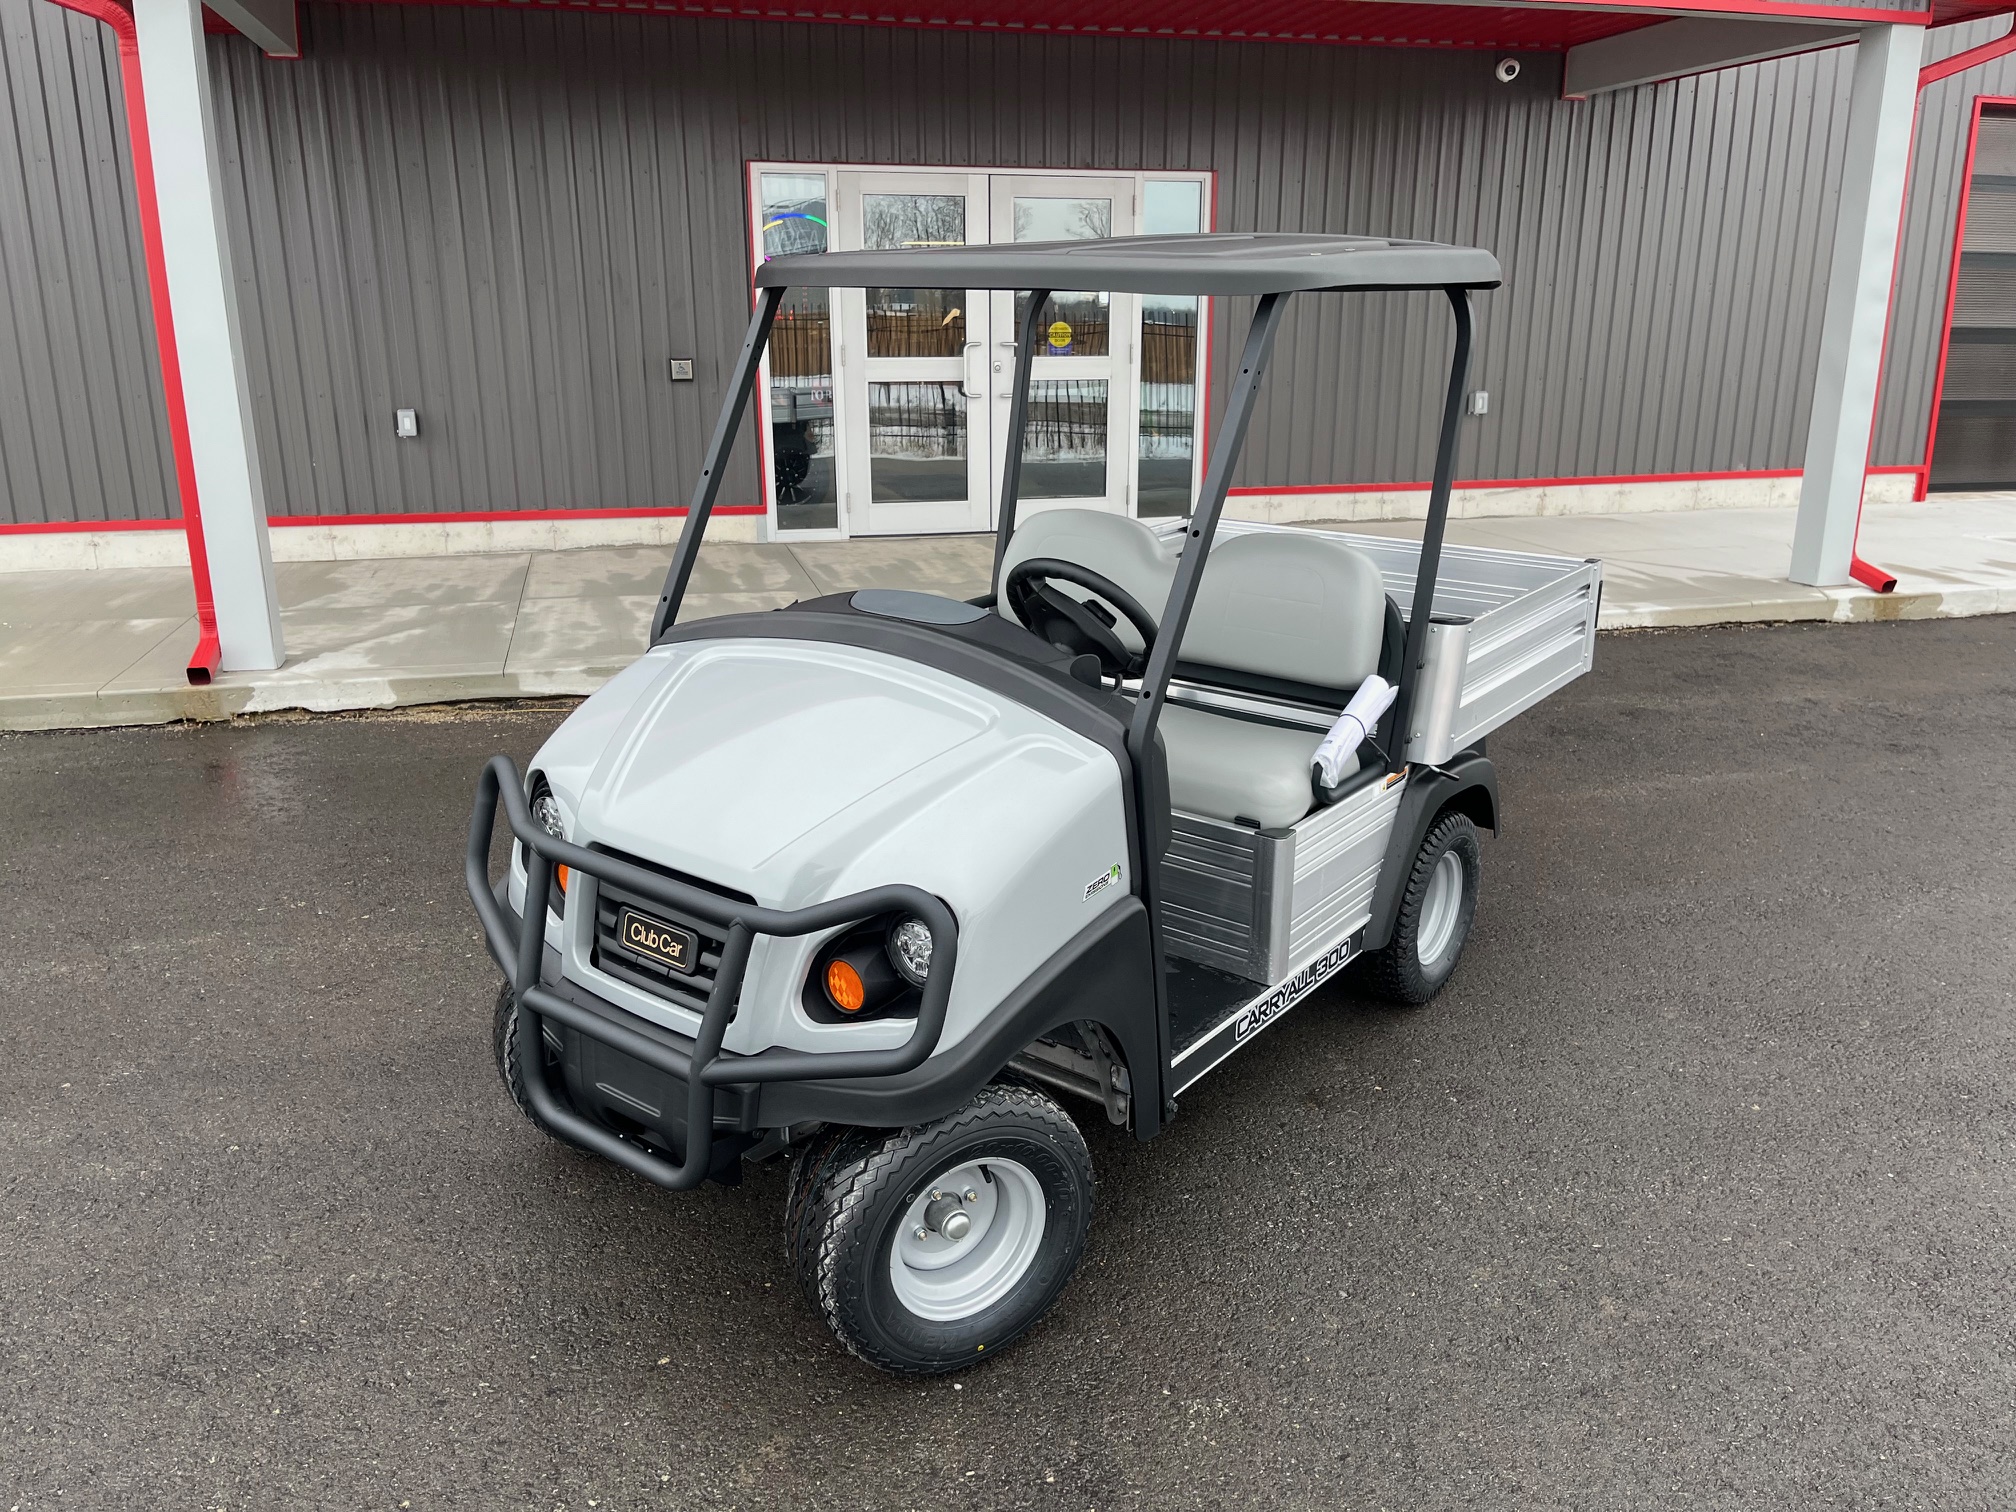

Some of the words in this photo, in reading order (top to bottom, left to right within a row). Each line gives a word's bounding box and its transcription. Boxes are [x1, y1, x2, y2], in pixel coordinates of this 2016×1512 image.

[1086, 872, 1110, 894] ZERO
[631, 923, 658, 948] Club
[660, 934, 683, 957] Car
[1236, 966, 1315, 1041] CARRYALL
[1316, 937, 1351, 980] 300
[885, 1309, 958, 1351] KENDA
